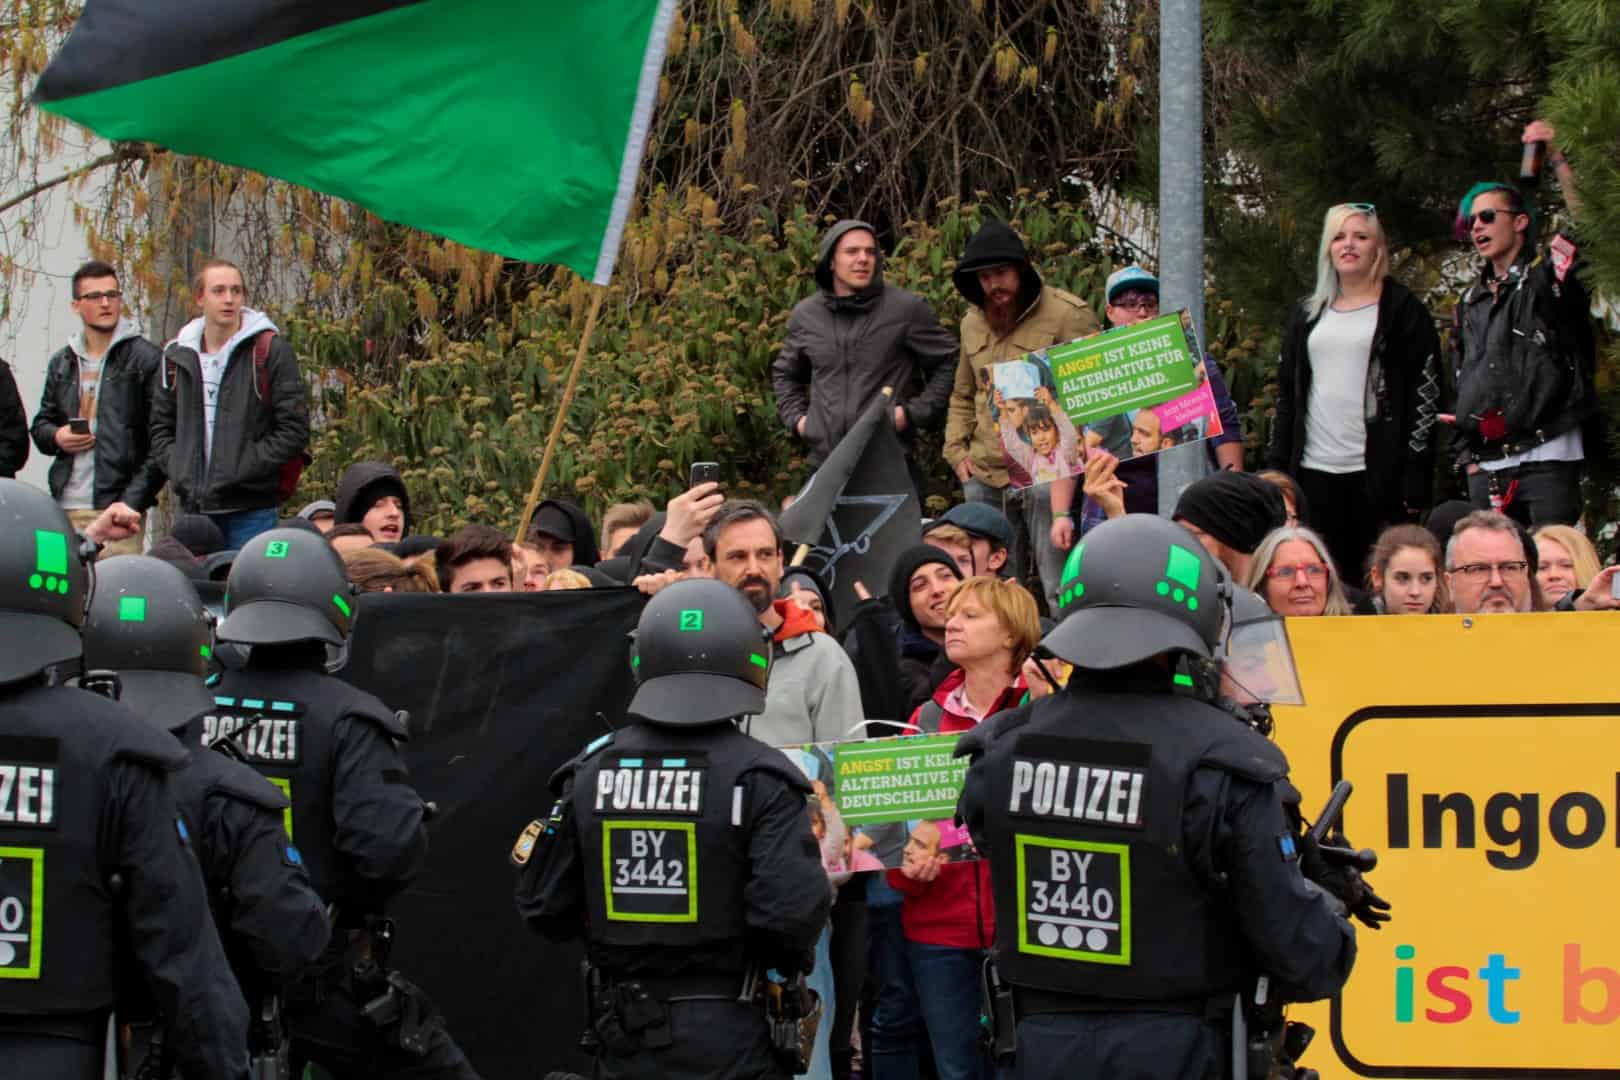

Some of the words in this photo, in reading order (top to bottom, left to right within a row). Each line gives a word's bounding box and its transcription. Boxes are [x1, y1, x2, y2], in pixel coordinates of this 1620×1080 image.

[1058, 353, 1102, 377] ANGST
[1104, 346, 1126, 364] IST
[1128, 333, 1172, 357] KEINE
[1062, 357, 1155, 394] ALTERNATIVE
[1065, 371, 1169, 410] DEUTSCHLAND.
[684, 612, 699, 628] 2
[840, 758, 893, 775] ANGST
[896, 756, 921, 769] IST
[840, 771, 949, 792] ALTERNATIVE
[595, 769, 701, 811] POLIZEI
[1009, 760, 1144, 824] POLIZEI
[1386, 771, 1620, 871] Ingo
[631, 829, 667, 858] BY
[615, 858, 684, 887] 3442
[1050, 849, 1094, 884] BY
[1031, 880, 1114, 920] 3440
[1395, 944, 1521, 1025] ist
